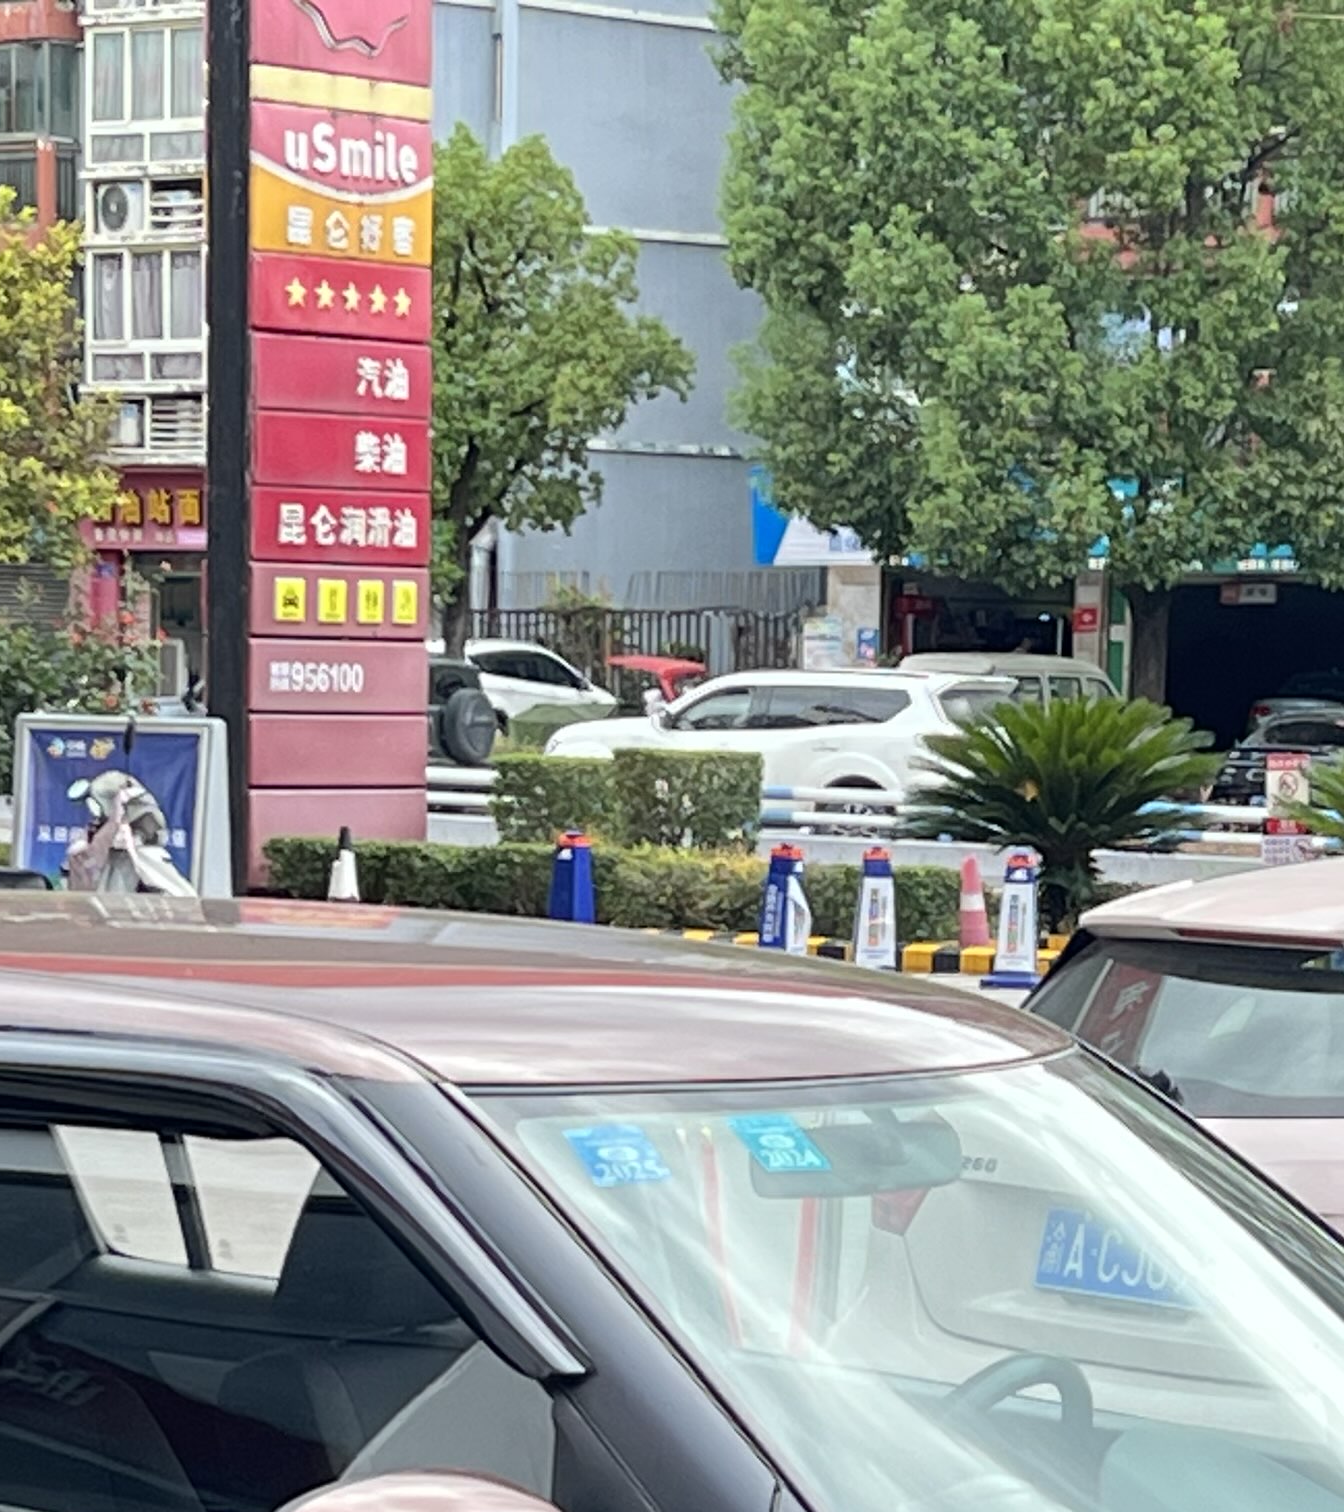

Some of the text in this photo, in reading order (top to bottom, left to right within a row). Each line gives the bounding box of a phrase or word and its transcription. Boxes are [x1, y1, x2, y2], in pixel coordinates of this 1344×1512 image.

[284, 122, 418, 184] uSmile
[287, 205, 416, 256] 昆仑好客
[356, 356, 409, 400] 汽油
[354, 430, 408, 475] 柴油
[278, 502, 418, 548] 昆仑润滑油
[291, 661, 364, 693] 956100
